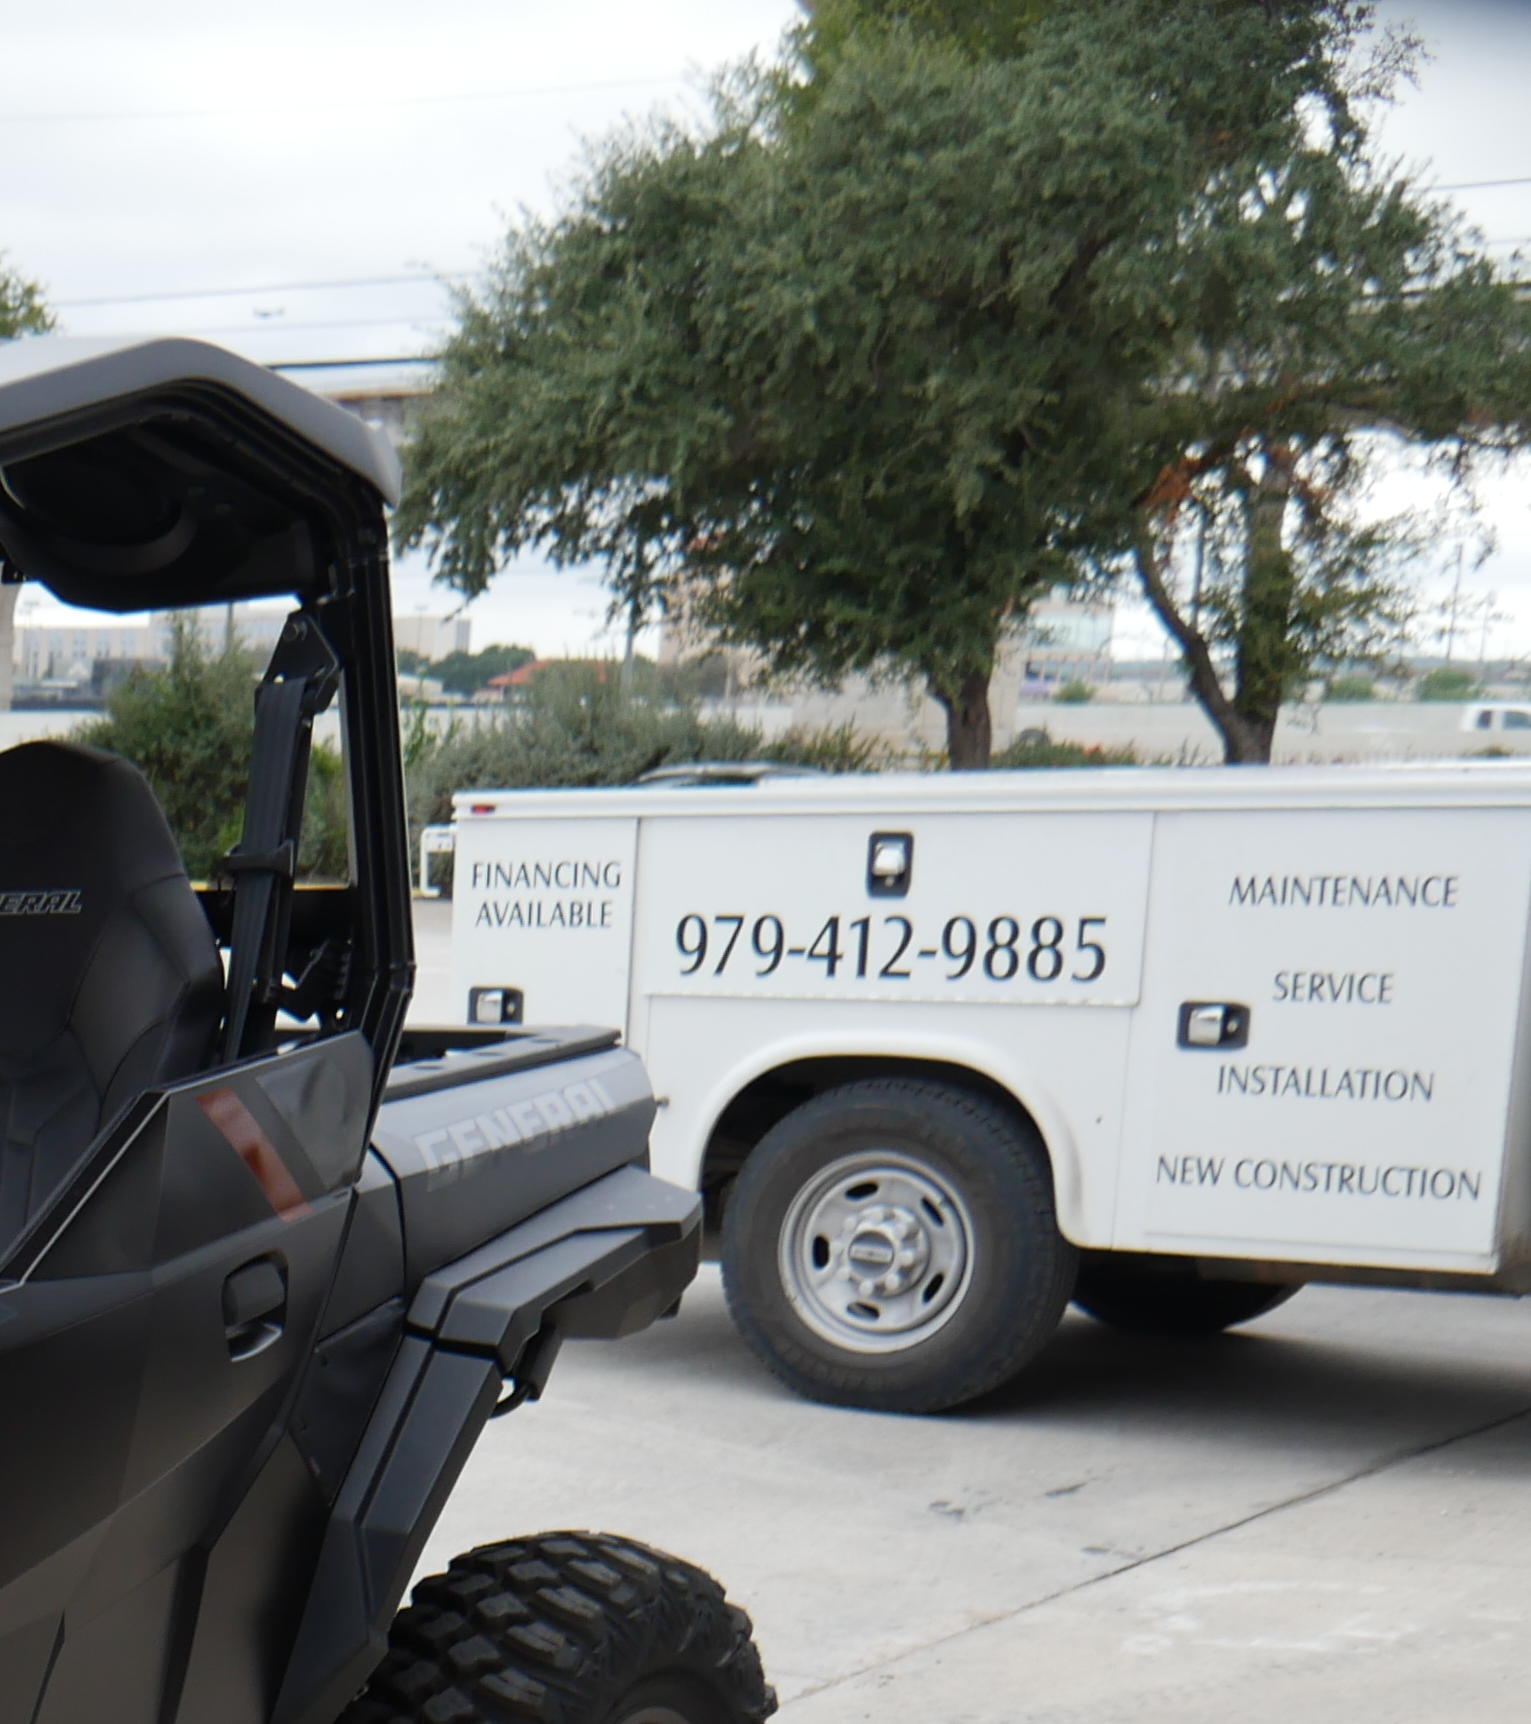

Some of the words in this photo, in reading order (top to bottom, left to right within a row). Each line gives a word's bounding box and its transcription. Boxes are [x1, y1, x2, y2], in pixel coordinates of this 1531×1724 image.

[471, 861, 622, 889] FINANCING
[1228, 875, 1458, 909] MAINTENANCE
[475, 900, 613, 928] AVAILABLE
[675, 912, 1108, 984] 979-412-9885
[1273, 971, 1394, 1005] SERVICE
[1217, 1064, 1434, 1102] INSTALLATION
[1156, 1155, 1227, 1187] NEW
[1234, 1158, 1482, 1201] CONSTRUCTION
